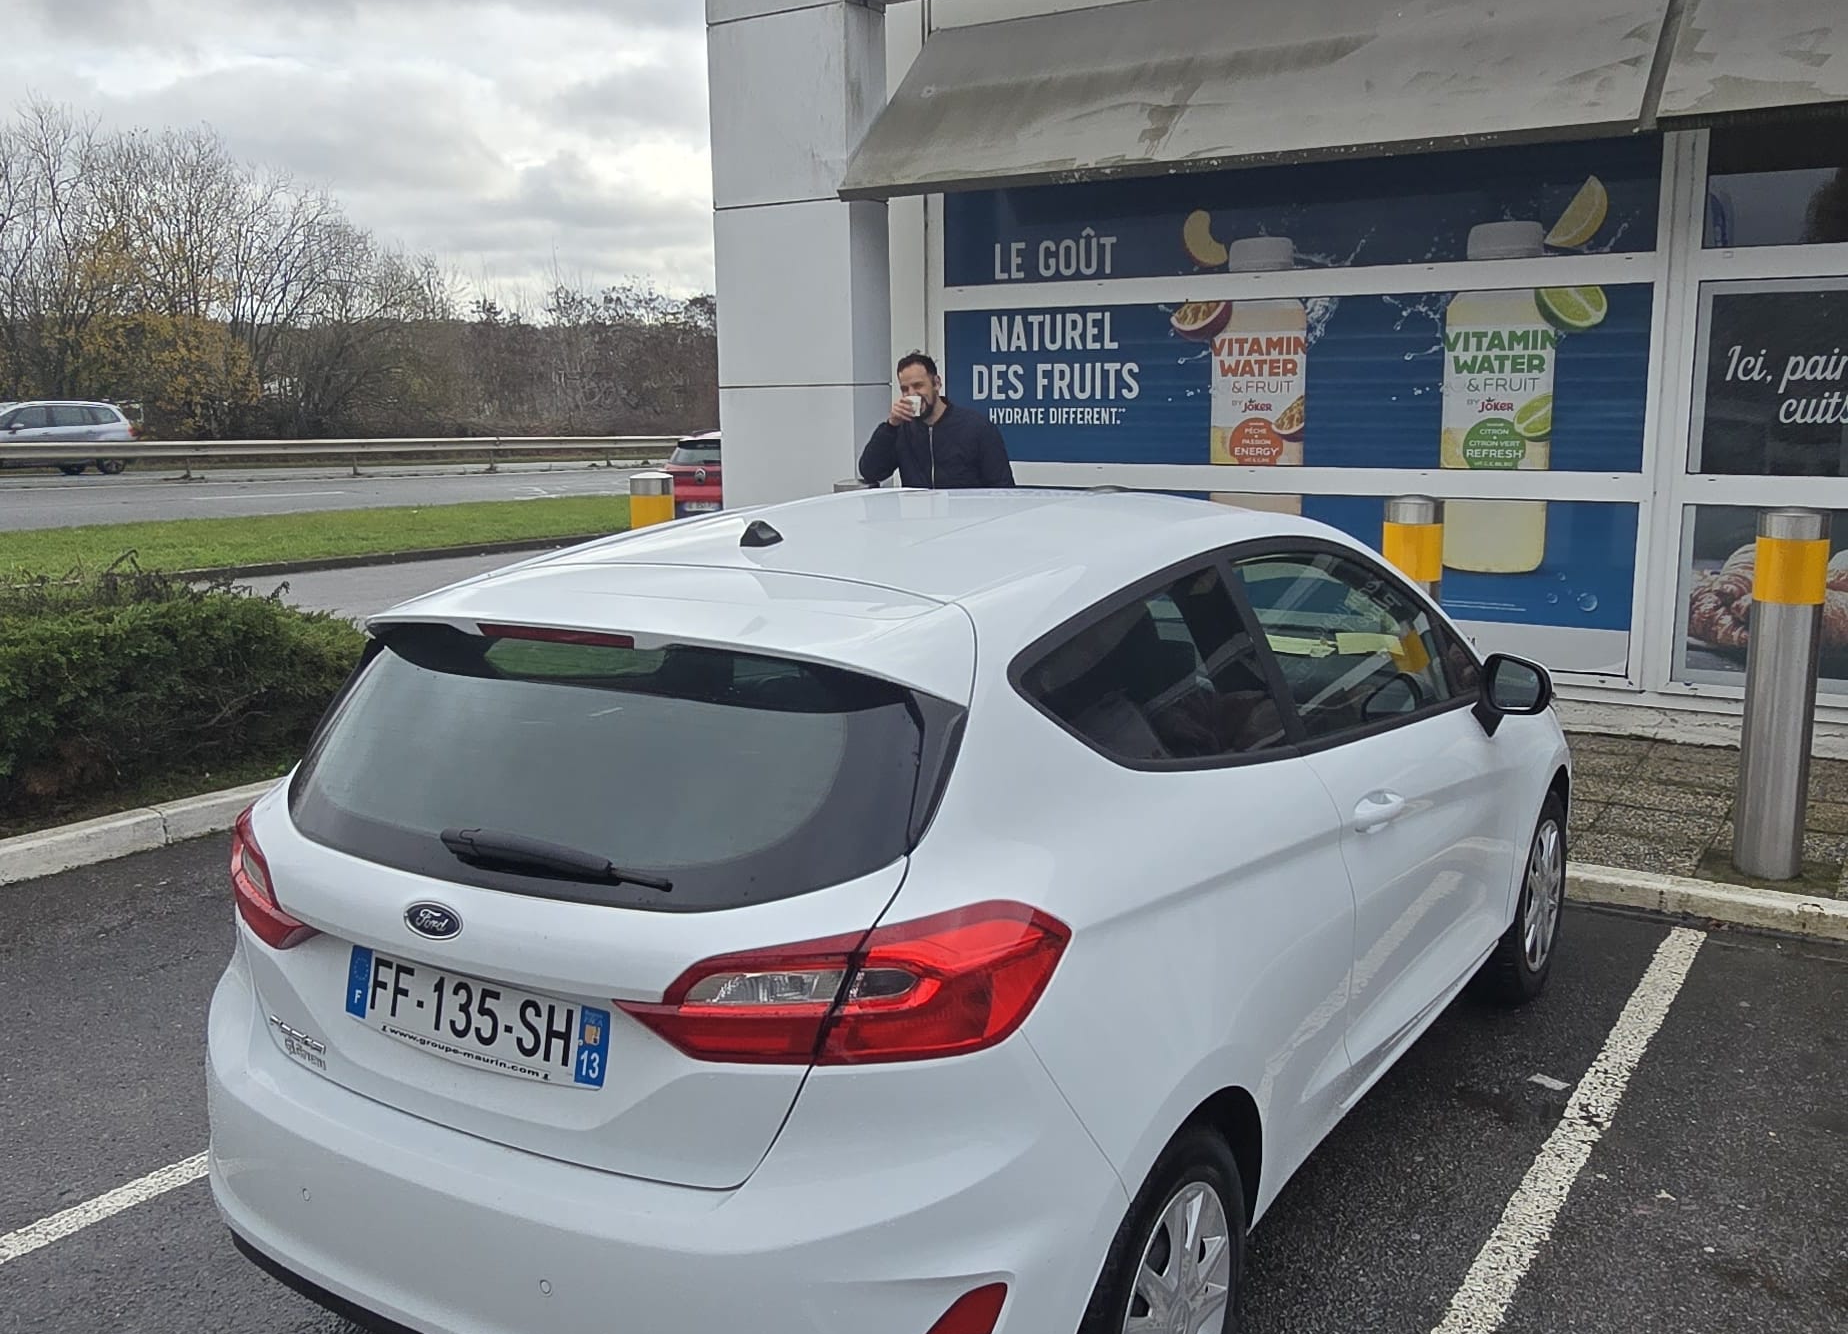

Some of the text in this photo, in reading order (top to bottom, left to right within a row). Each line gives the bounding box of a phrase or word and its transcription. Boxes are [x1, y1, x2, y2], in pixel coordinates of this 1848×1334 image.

[994, 226, 1117, 280] LE GOÛT
[990, 311, 1119, 352] NATUREL
[1445, 330, 1556, 352] VITAMIN
[1211, 336, 1307, 357] VITAMIN
[1219, 359, 1298, 377] WATER
[1453, 354, 1546, 374] WATER
[1725, 345, 1772, 384] Ici,
[972, 362, 1140, 400] DES FRUITS
[1232, 380, 1294, 394] & FRUIT
[1467, 378, 1540, 392] & FRUIT
[989, 407, 1045, 424] HYDRATE
[1234, 447, 1279, 456] ENERGY
[1466, 449, 1522, 458] REFRESH
[416, 908, 449, 932] Ford
[354, 989, 362, 1004] F
[369, 956, 574, 1068] FF-135-SH
[580, 1050, 600, 1079] 13
